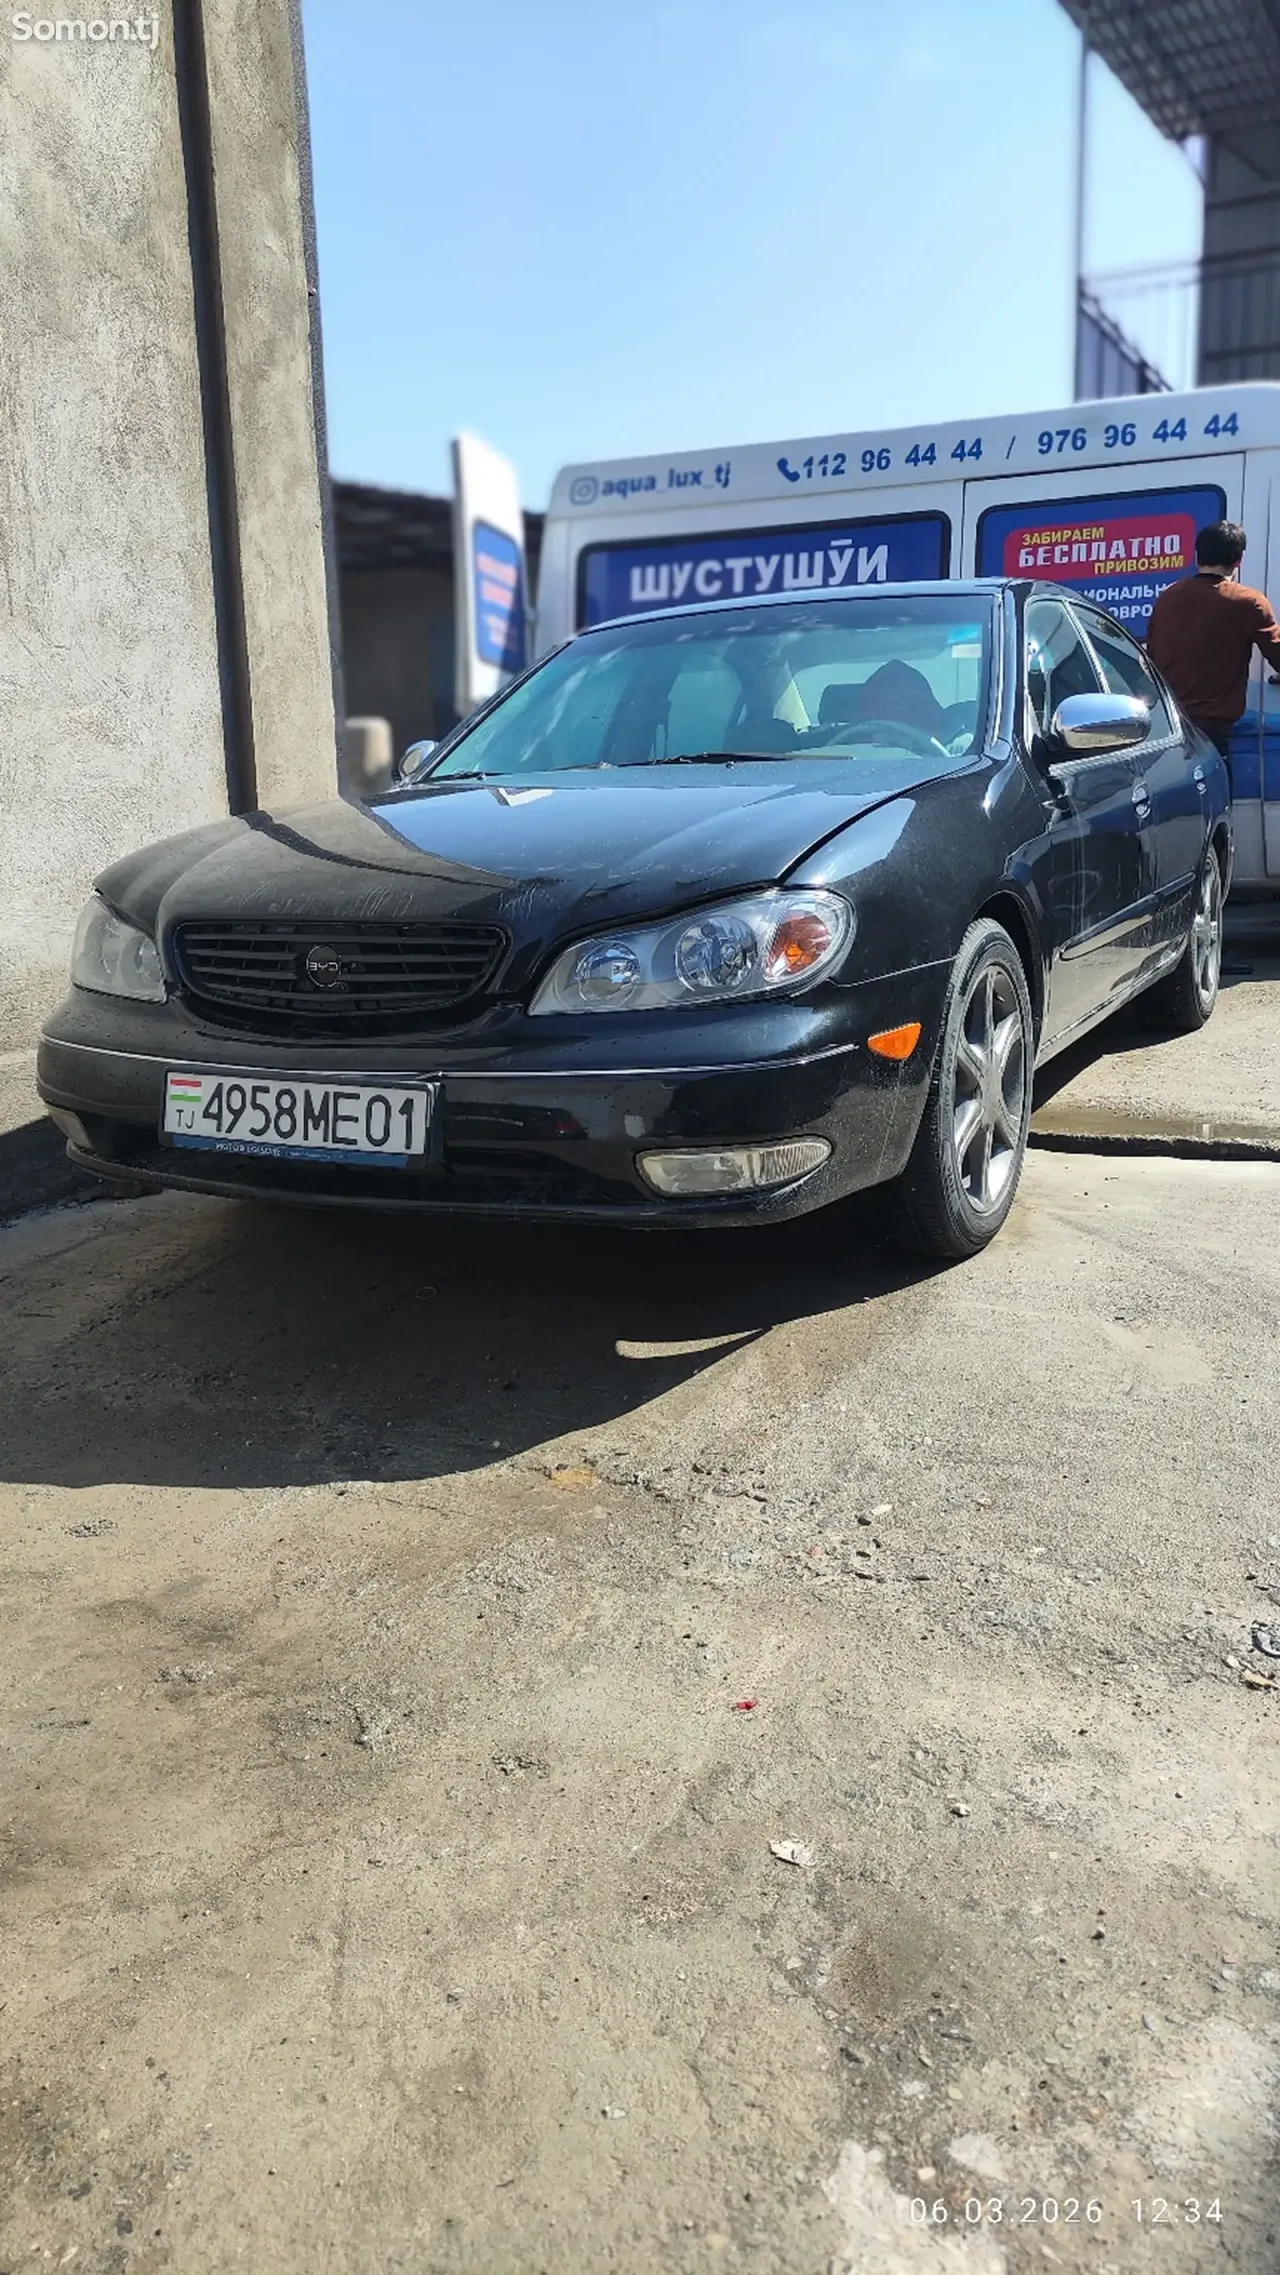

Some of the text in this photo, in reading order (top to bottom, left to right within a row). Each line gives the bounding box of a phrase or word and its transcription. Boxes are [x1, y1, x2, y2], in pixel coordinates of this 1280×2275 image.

[802, 452, 847, 479] 112
[860, 447, 892, 474] 96
[904, 441, 937, 468] 44
[950, 436, 984, 463] 44
[1036, 426, 1088, 456] 976
[1102, 422, 1137, 449] 96
[1152, 416, 1188, 444] 44
[1203, 411, 1240, 439] 44
[600, 460, 733, 500] aqua_lux_tj
[1018, 533, 1182, 568] БЕСПЛАТНО
[1021, 526, 1106, 547] ЗАБИРАЕМ
[1093, 554, 1185, 576] ПРИВОЗИМ
[1081, 582, 1167, 602] ИОНАЛЬН
[308, 961, 339, 972] BYD
[175, 1081, 415, 1151] TJ 4958ME01
